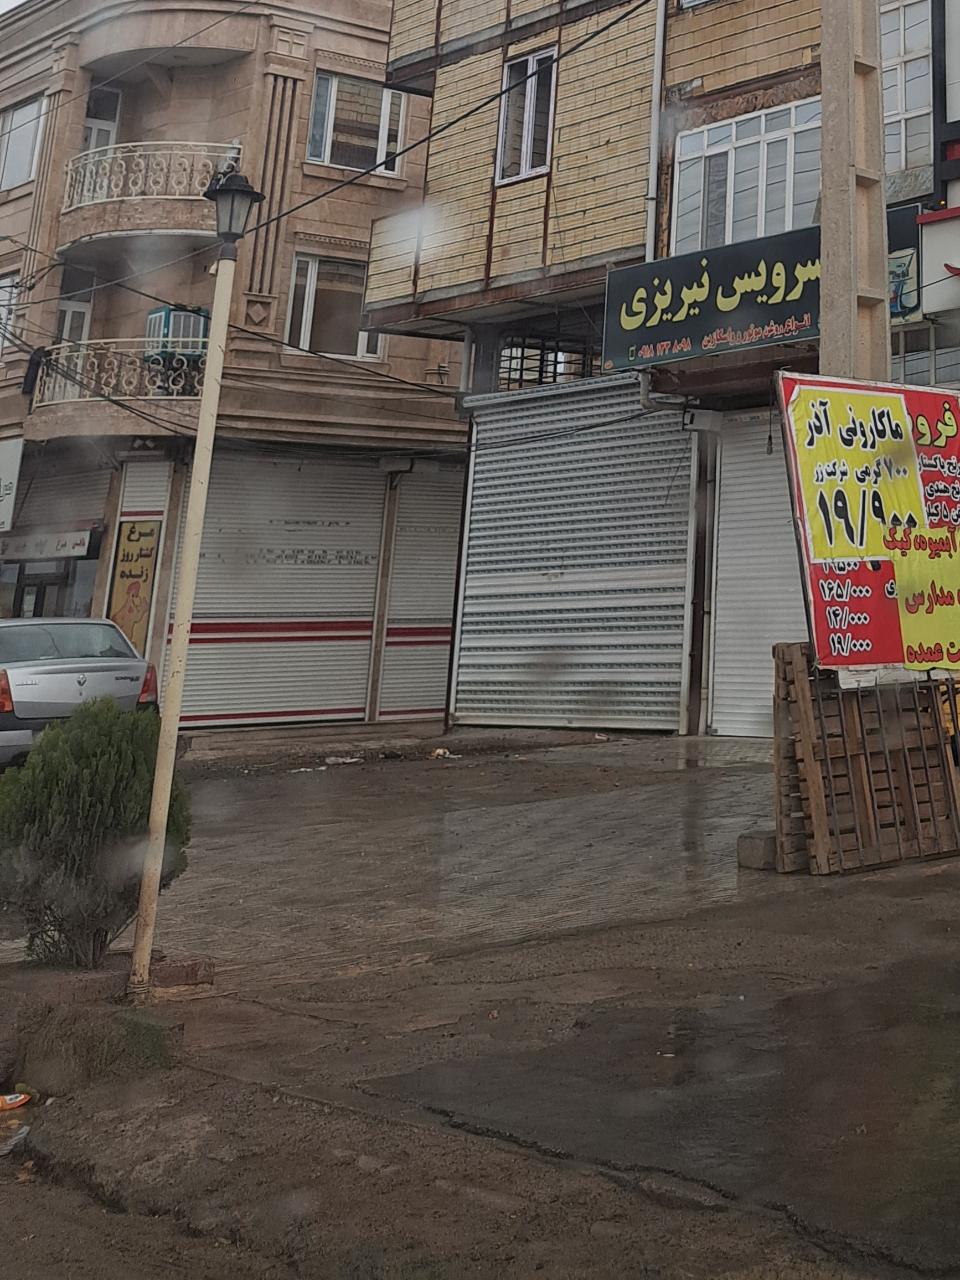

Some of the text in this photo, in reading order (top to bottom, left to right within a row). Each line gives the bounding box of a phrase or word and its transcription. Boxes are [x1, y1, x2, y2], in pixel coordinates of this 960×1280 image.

[619, 252, 821, 331] سرویس نیریزی
[806, 400, 904, 450] ماکارونی آذر
[908, 400, 958, 449] فرو
[814, 456, 908, 486] ۷۰۰ گرمی شرکت زر
[918, 452, 947, 476] پاکستا
[925, 480, 950, 500] هندی
[816, 487, 918, 548] ۱۹/۹۰۰
[883, 524, 912, 557] کیک
[120, 565, 149, 583] زنده
[819, 578, 872, 602] ۱۶۵/۰۰۰
[905, 580, 955, 615] مدارس
[829, 632, 872, 657] ۱۹/۰۰۰
[905, 640, 944, 665] عمده
